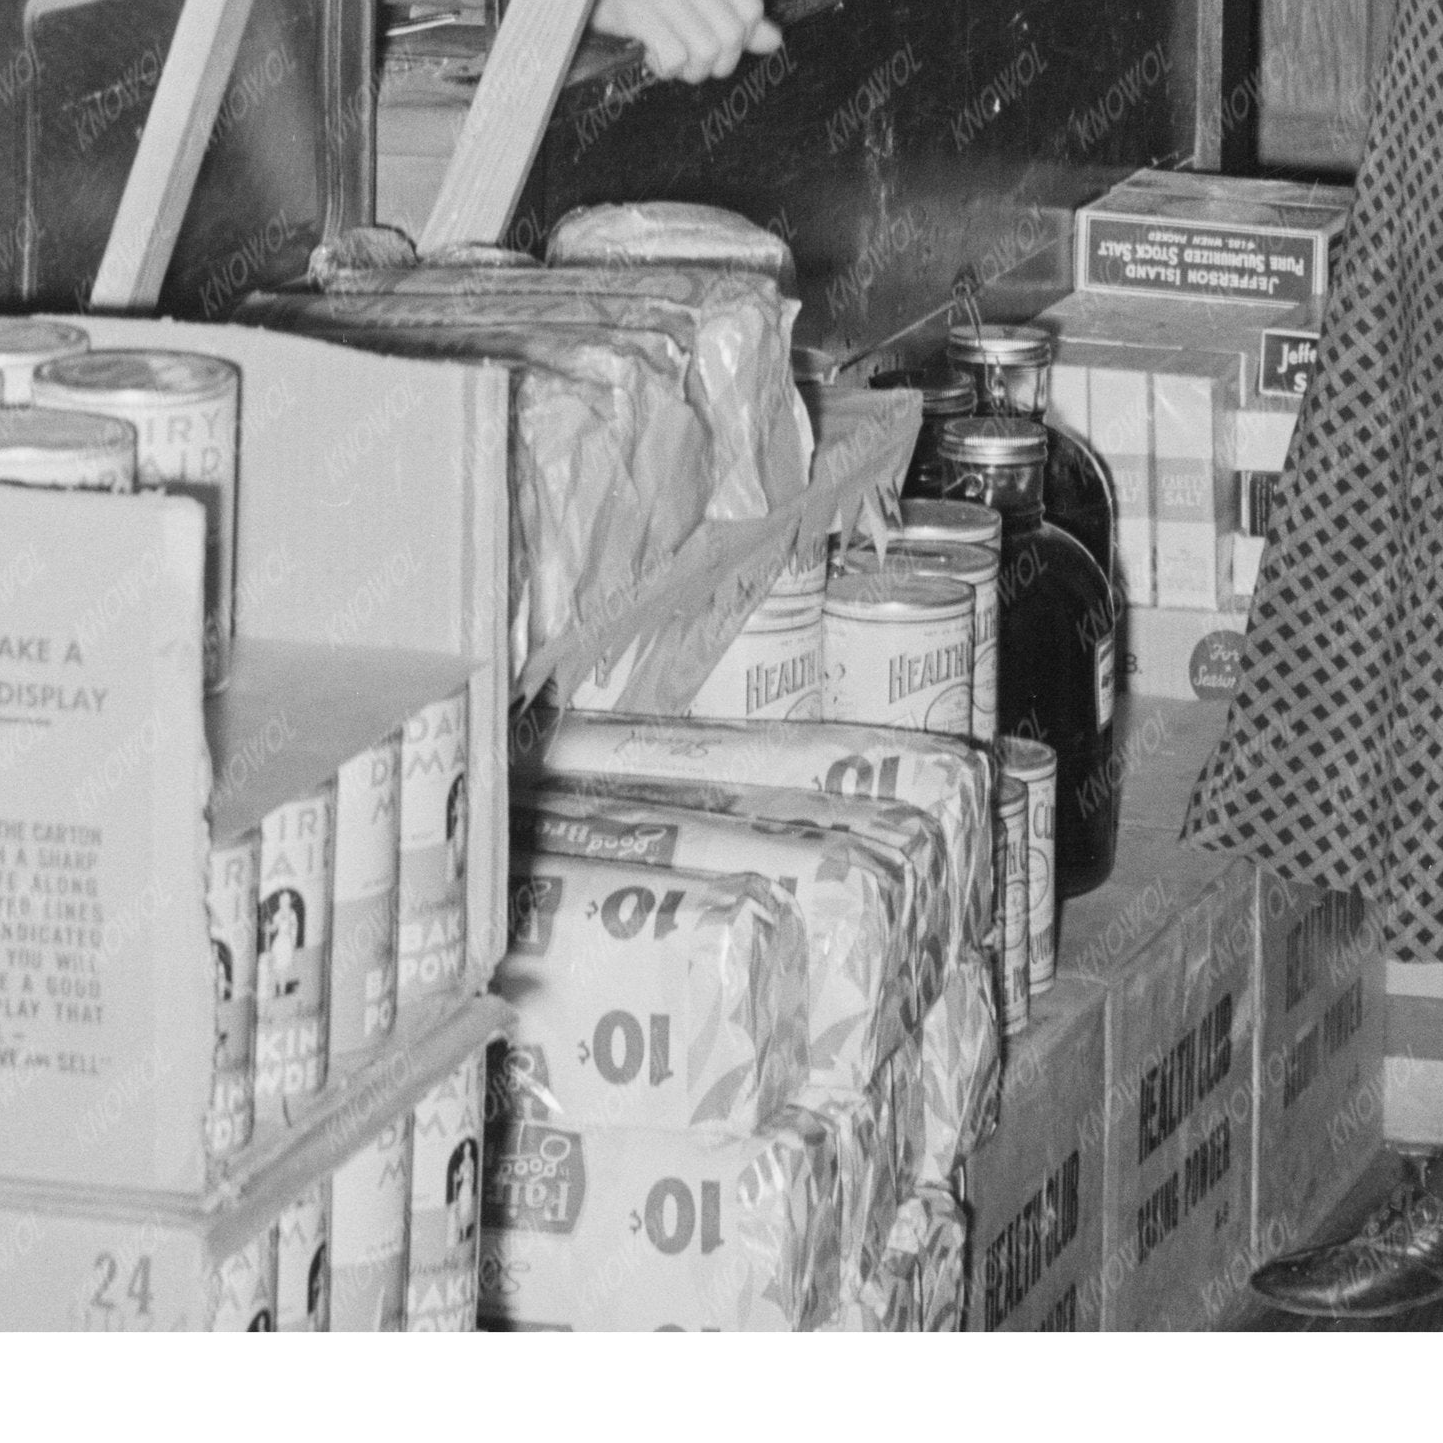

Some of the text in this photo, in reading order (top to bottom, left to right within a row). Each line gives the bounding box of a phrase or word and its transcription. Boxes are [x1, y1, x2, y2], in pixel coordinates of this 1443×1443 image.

[1148, 232, 1187, 244] PACKED
[1192, 236, 1223, 248] WHEN
[1098, 240, 1305, 276] PURE SULPHURIZED STOCK SALT
[1125, 264, 1279, 294] JEFFERSON ISLAND
[64, 639, 84, 666] A
[15, 847, 27, 867] A
[30, 874, 99, 898] ALONG
[43, 899, 104, 923] LINES
[584, 886, 687, 942] 10¢
[5, 948, 42, 970] YOU
[21, 973, 33, 994] A
[46, 975, 102, 1000] GOOD
[55, 998, 104, 1025] THAT
[575, 1009, 674, 1088] 10¢
[627, 1176, 725, 1257] 10¢
